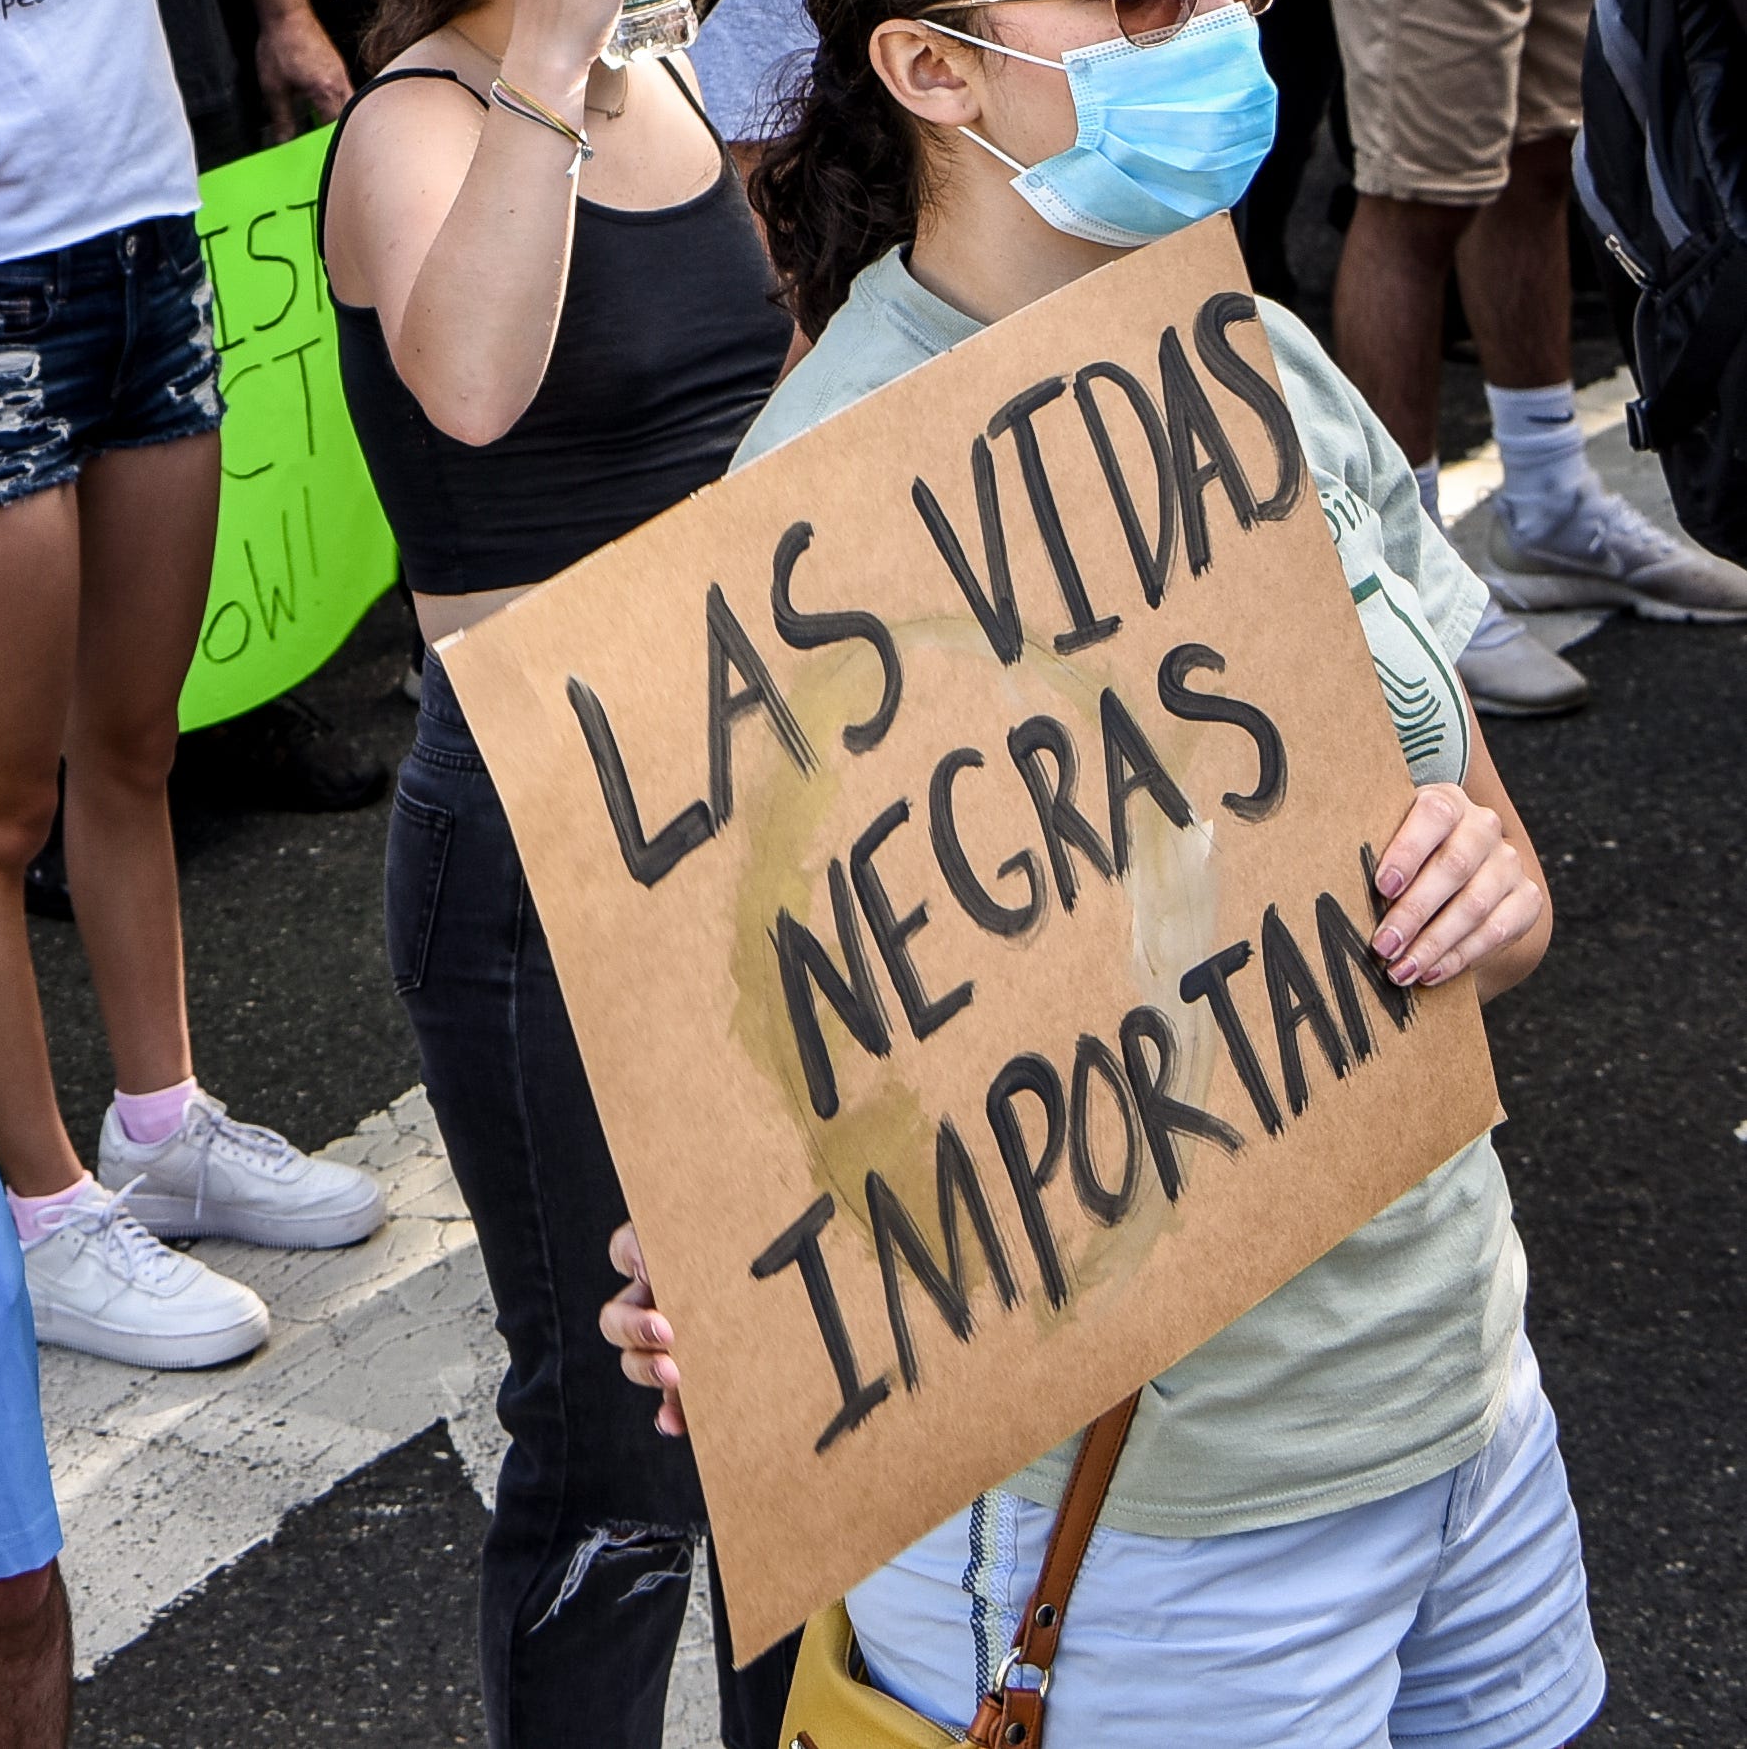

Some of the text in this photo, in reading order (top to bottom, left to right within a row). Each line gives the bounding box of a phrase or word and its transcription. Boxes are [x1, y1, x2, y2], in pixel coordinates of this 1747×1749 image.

[565, 290, 1309, 890] LAS VIDAS
[766, 640, 1288, 1122] NEGRAS
